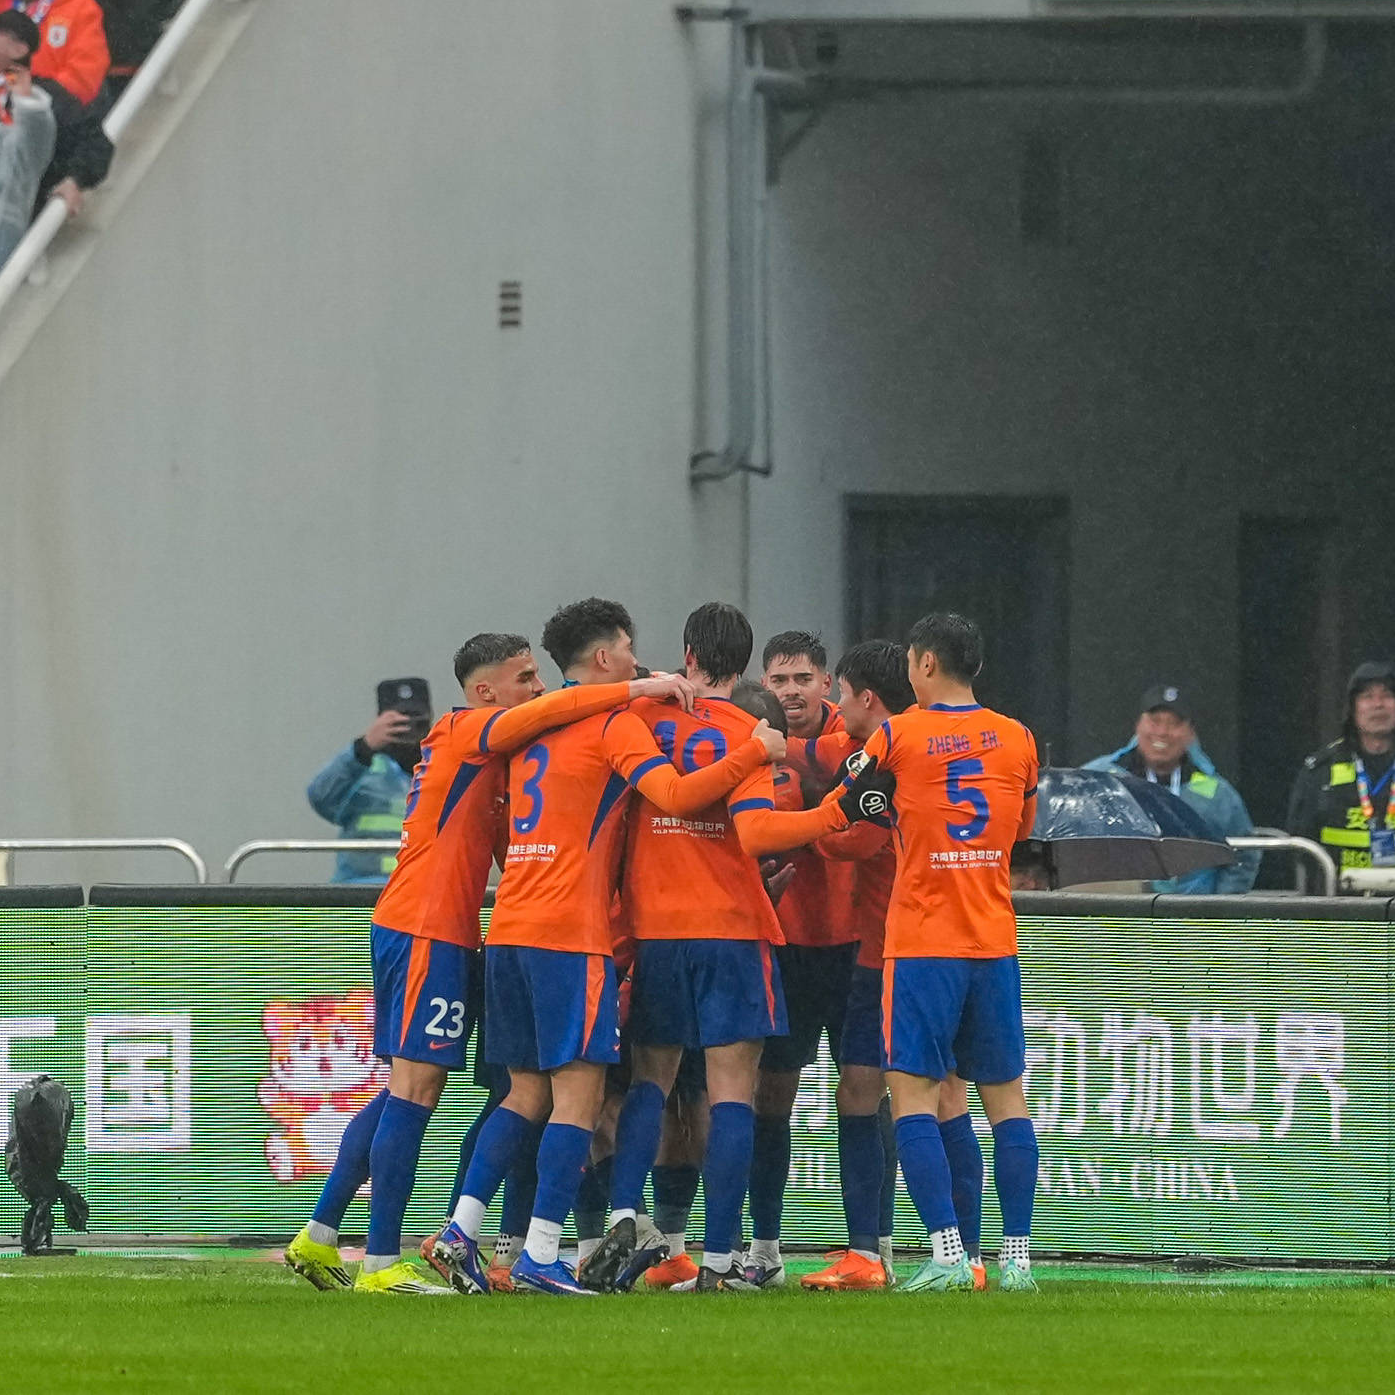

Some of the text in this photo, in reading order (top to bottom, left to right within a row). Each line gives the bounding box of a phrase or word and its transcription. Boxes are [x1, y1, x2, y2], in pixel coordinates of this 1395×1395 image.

[927, 735, 971, 755] ZHENG
[513, 743, 550, 835] 3
[946, 758, 990, 842] 5
[424, 997, 466, 1039] 23
[1131, 1159, 1240, 1201] CHINA
